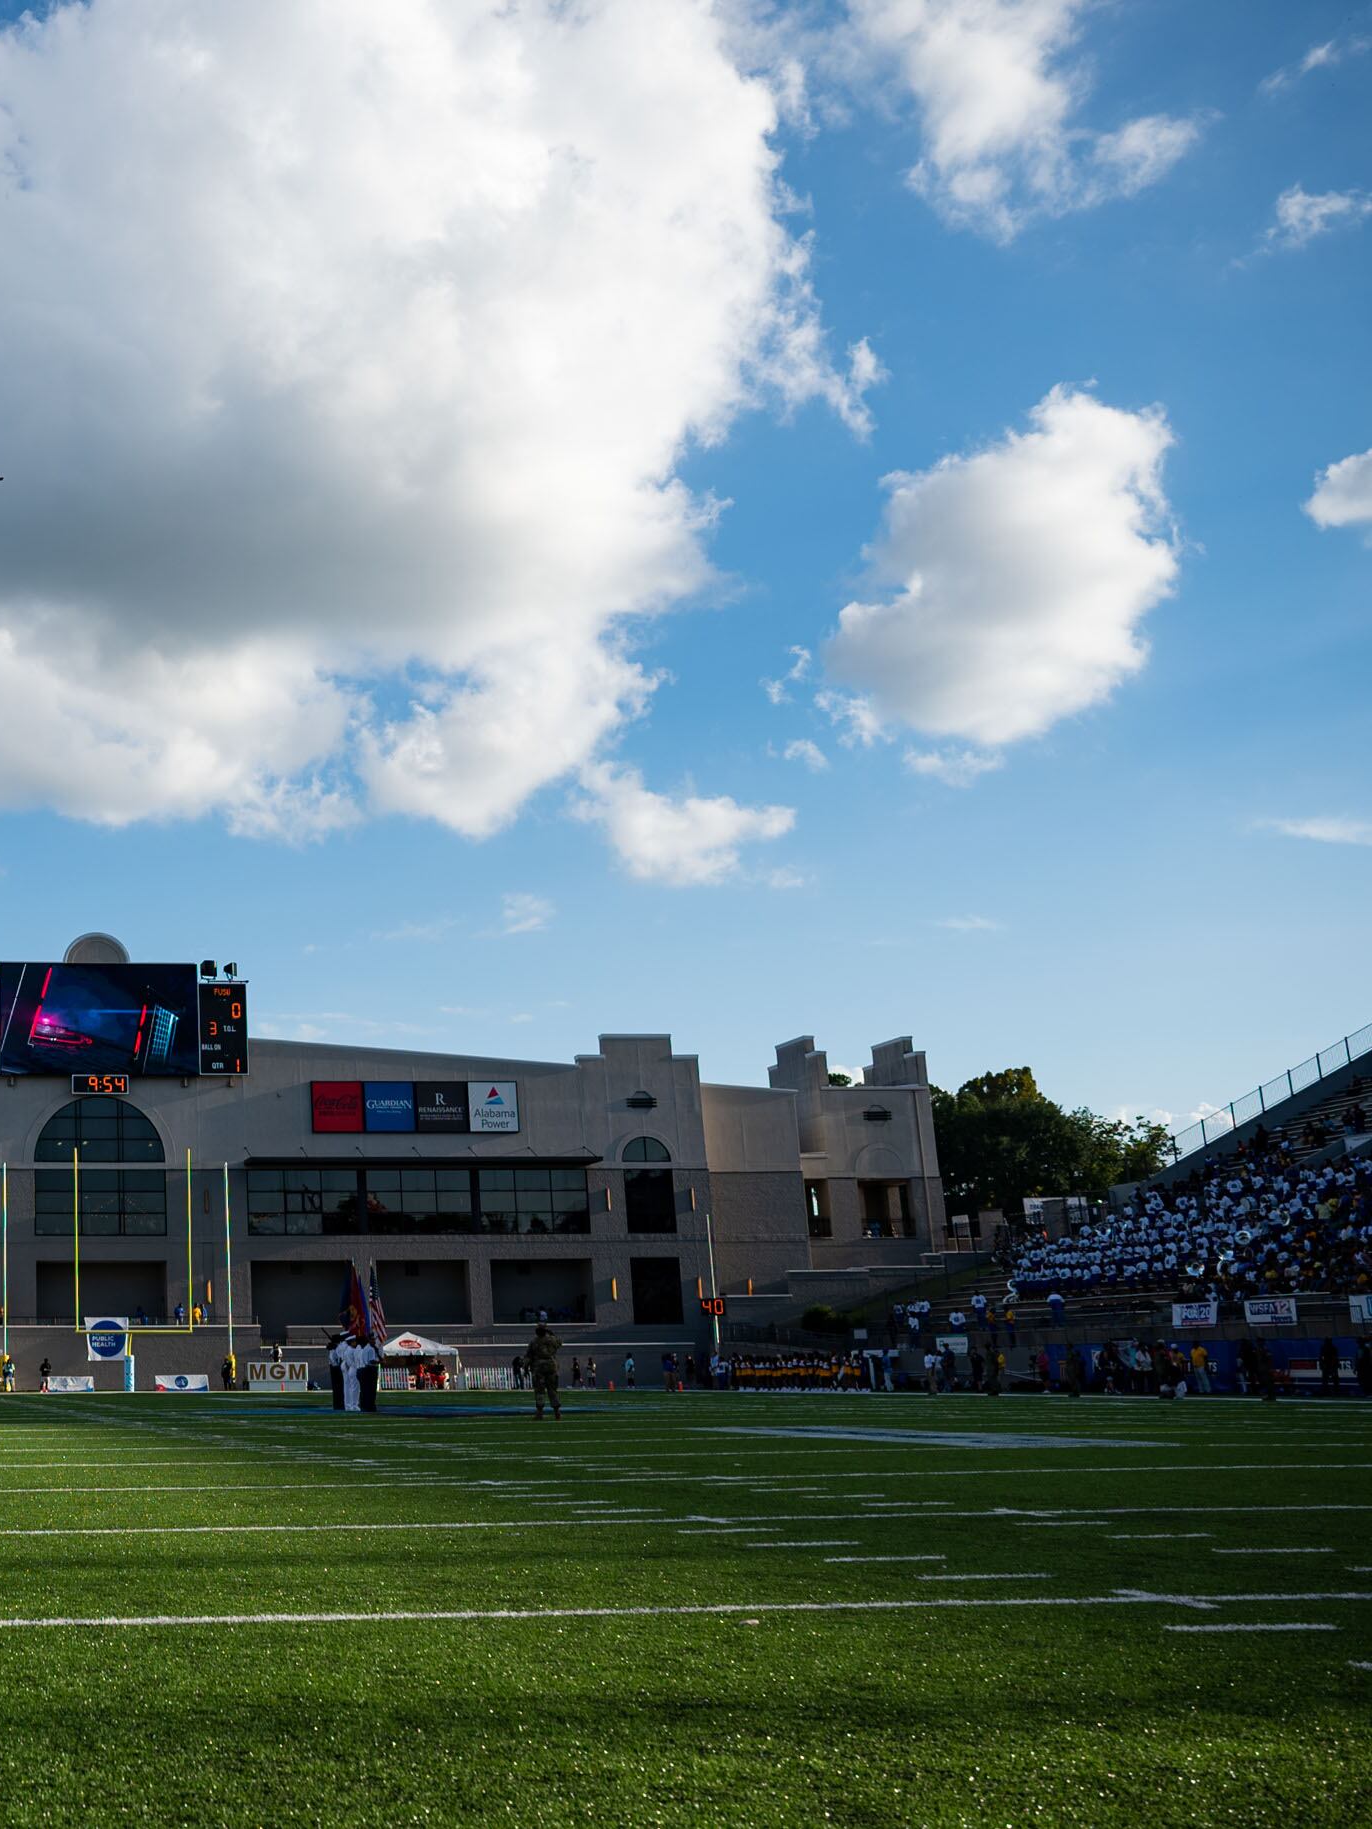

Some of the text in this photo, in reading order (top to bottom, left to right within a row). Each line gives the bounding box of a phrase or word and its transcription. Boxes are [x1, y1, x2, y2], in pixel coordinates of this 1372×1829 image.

[231, 1002, 241, 1019] 0
[210, 1021, 217, 1036] 3
[201, 1043, 213, 1051] BALL
[212, 1062, 225, 1070] QTR
[88, 1076, 125, 1092] 9:54
[366, 1099, 412, 1109] GUARDIAN
[435, 1093, 446, 1105] R
[474, 1108, 516, 1118] Alabama
[481, 1119, 509, 1128] Power
[701, 1299, 725, 1315] 40
[1250, 1300, 1290, 1315] WSFA 12
[249, 1364, 306, 1380] MGM
